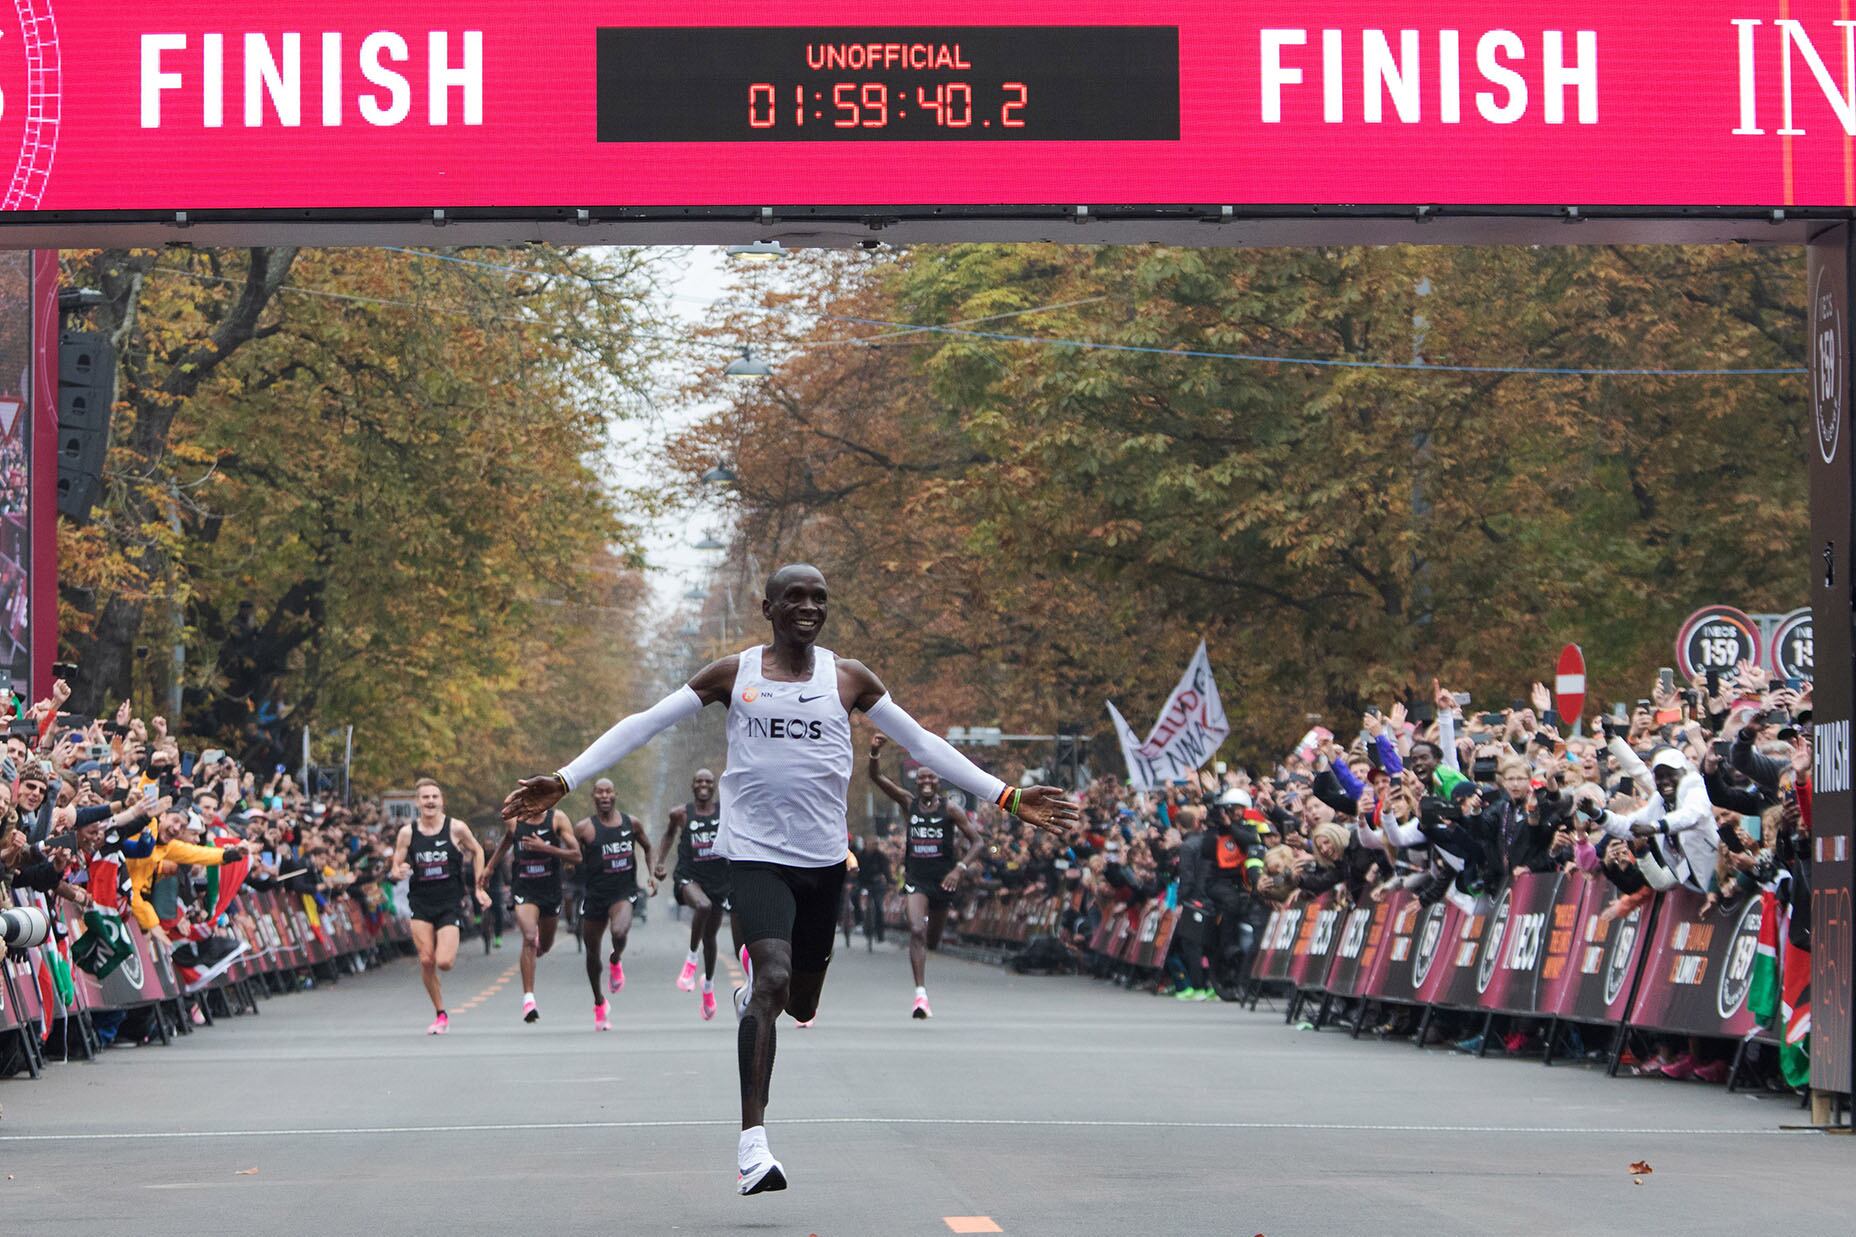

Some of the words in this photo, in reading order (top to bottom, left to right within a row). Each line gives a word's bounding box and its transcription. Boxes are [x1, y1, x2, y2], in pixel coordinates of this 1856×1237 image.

[806, 42, 972, 71] UNOFFICIAL
[140, 30, 483, 129] FINISH
[1260, 28, 1599, 125] FINISH
[748, 81, 1028, 129] 01:59:40.2
[760, 691, 774, 699] NN
[748, 717, 822, 740] INEOS
[1814, 719, 1850, 794] FINISH
[911, 826, 944, 839] INEOS
[415, 850, 448, 864] INEOS
[602, 840, 633, 856] INEOS
